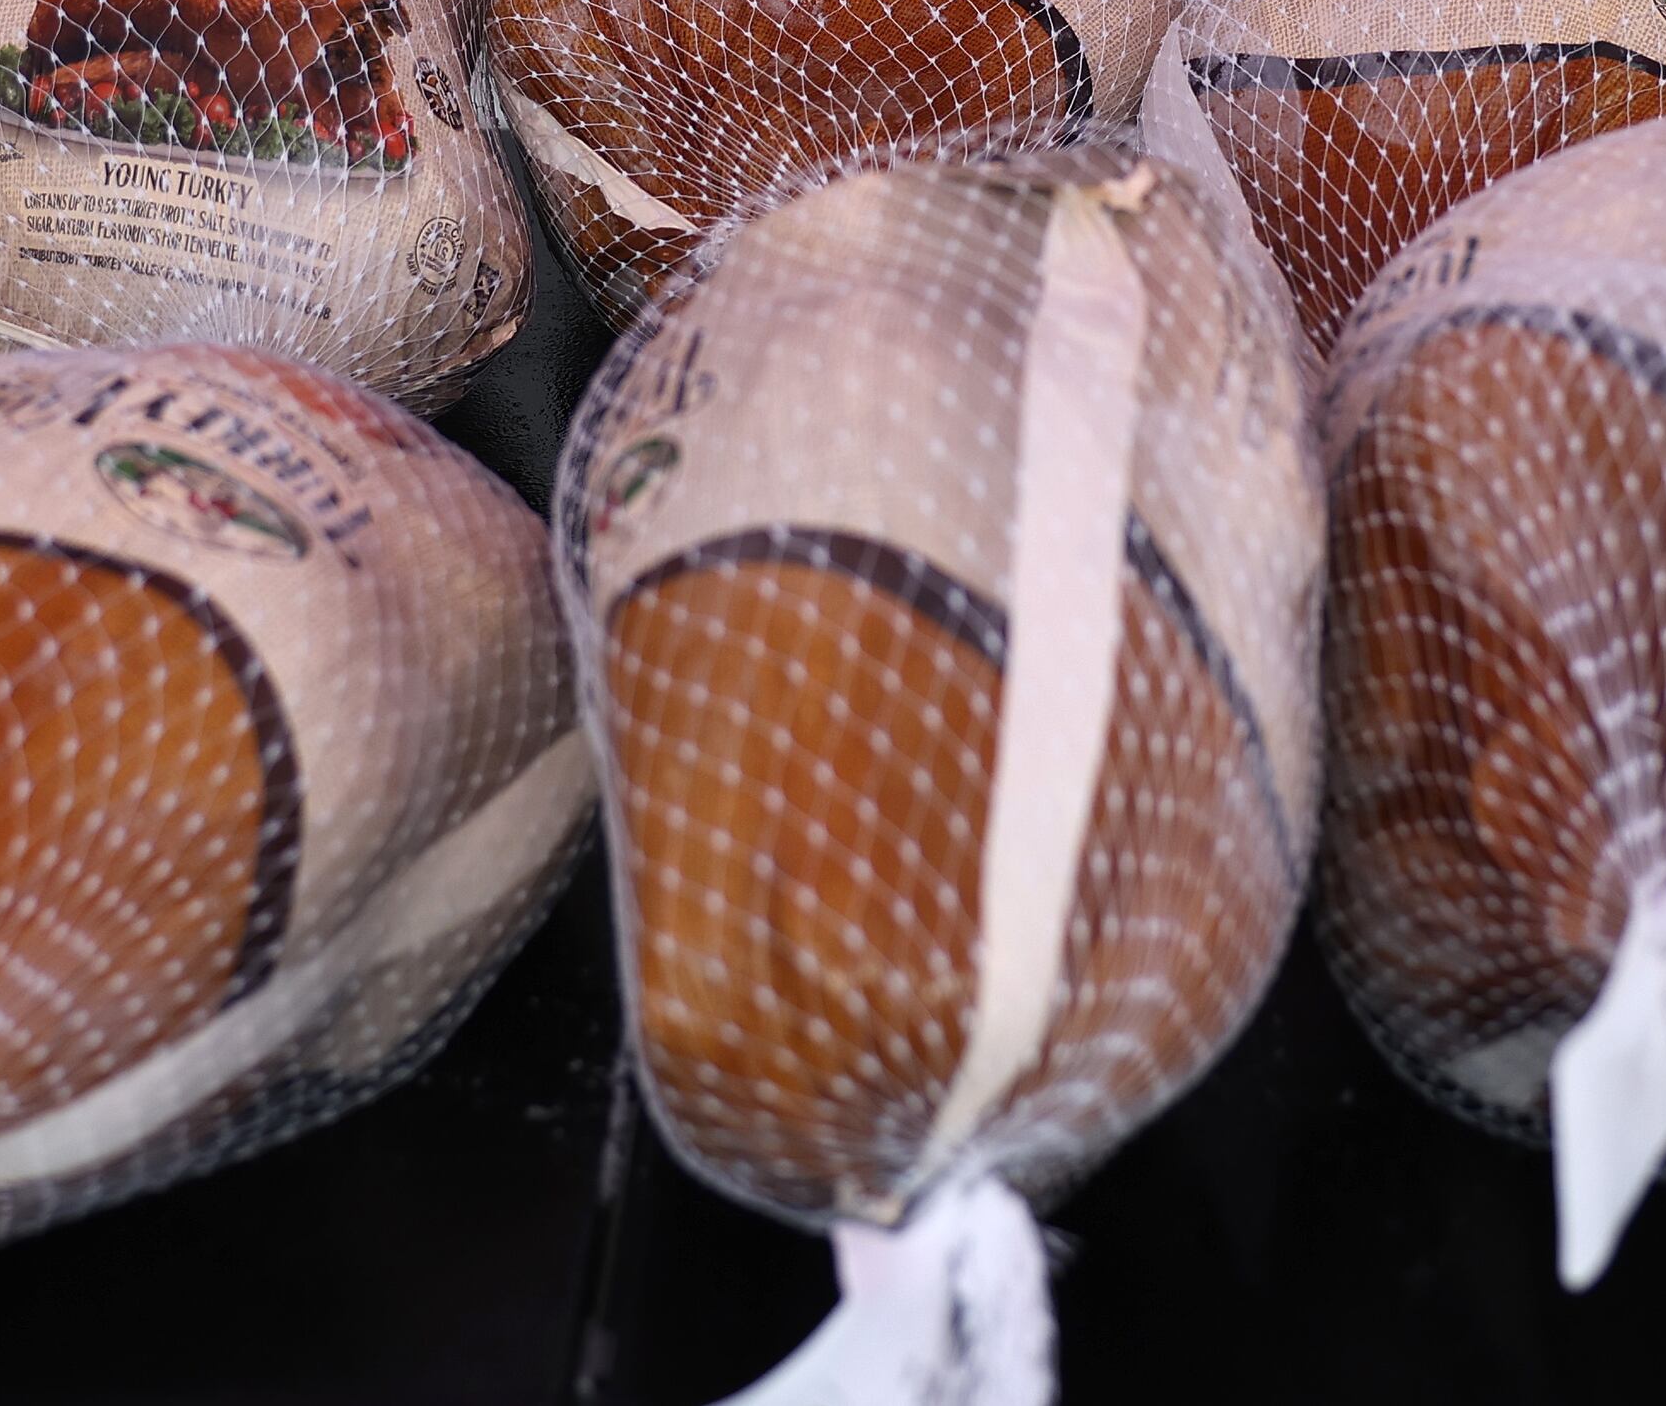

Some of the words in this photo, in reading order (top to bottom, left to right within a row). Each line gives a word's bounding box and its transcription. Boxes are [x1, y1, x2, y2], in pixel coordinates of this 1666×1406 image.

[103, 161, 172, 193] YOUNG
[177, 170, 254, 210] TURKEY
[68, 195, 81, 211] UP
[83, 195, 96, 213] TO
[121, 199, 159, 221] TURKEY
[27, 215, 55, 236] SUGAR,
